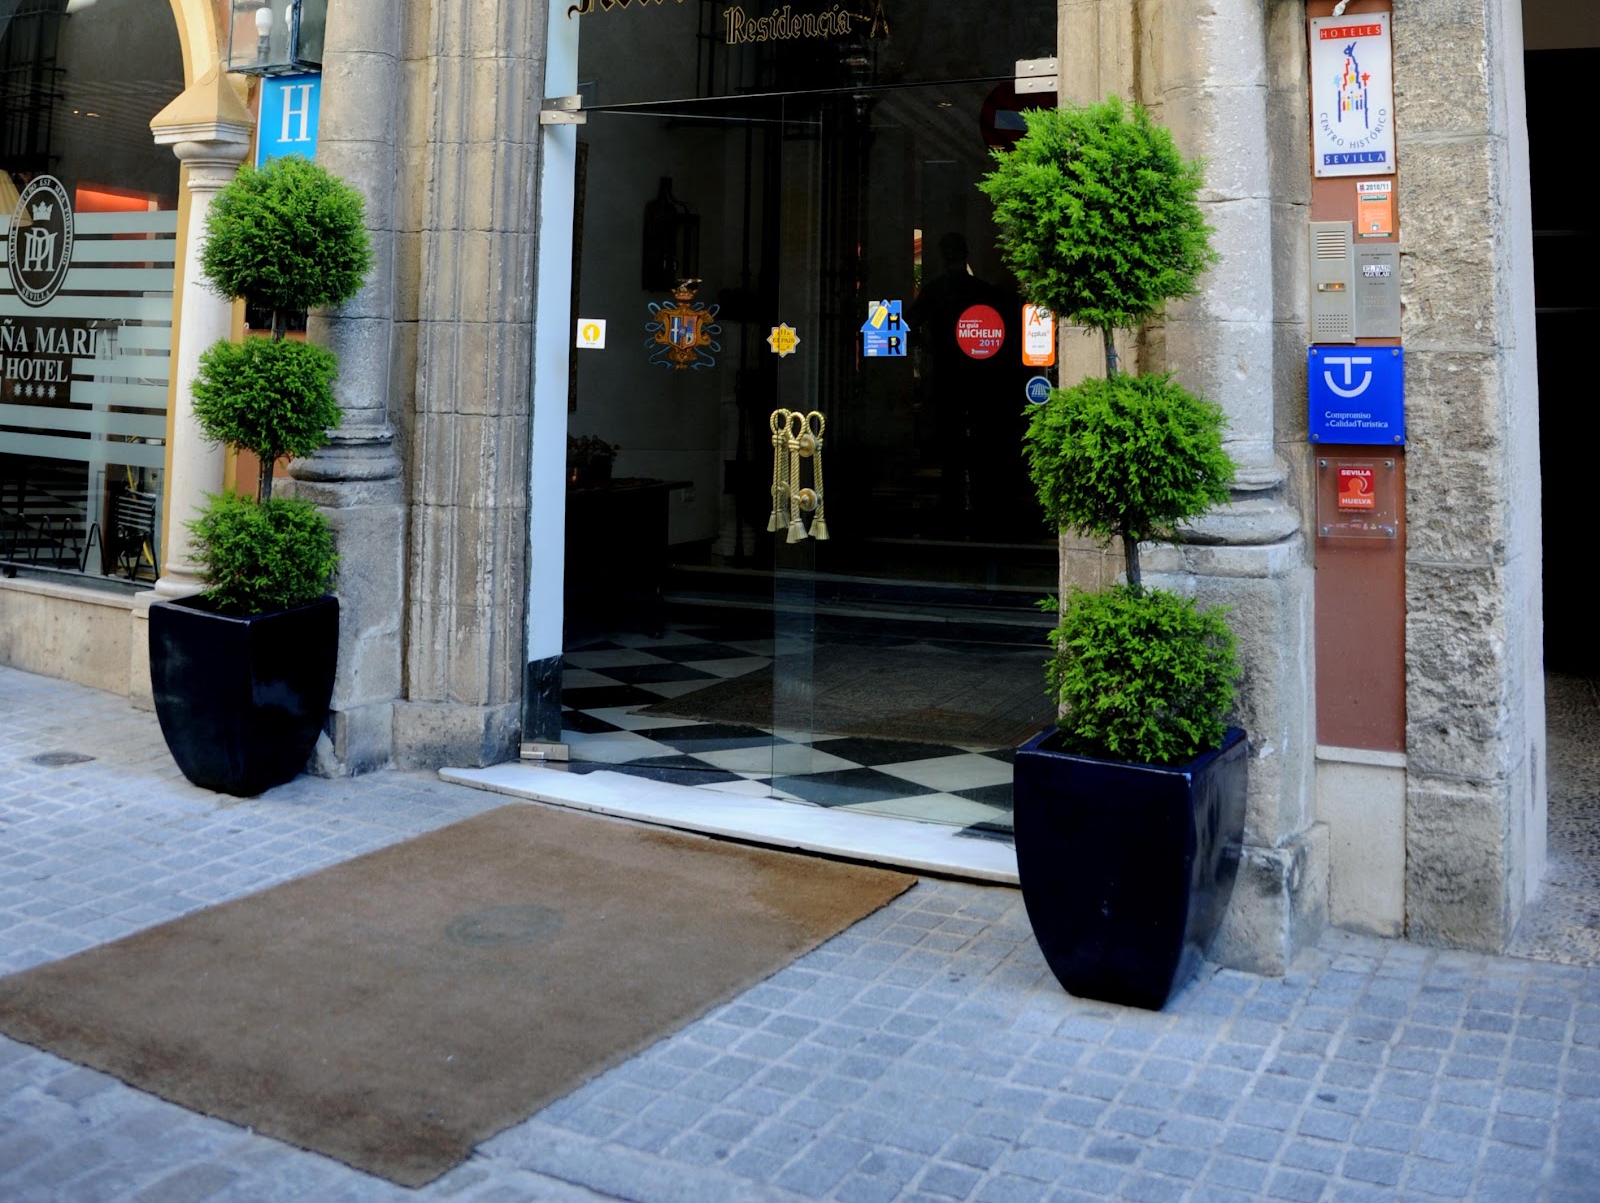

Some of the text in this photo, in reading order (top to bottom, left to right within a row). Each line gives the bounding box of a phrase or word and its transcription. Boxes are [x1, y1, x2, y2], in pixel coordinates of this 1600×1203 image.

[723, 4, 853, 45] Residencia
[1320, 25, 1381, 39] HOTELES
[277, 83, 315, 143] H
[1320, 108, 1387, 149] CENTRO HISTÓRICO
[1325, 151, 1385, 164] SEVILLA
[22, 287, 51, 301] SEVILLA
[35, 320, 112, 358] MARÍA
[958, 329, 1002, 338] MICHELIN
[979, 339, 1000, 347] 2011
[5, 357, 68, 383] HOTEL
[1325, 411, 1371, 420] Compromiso
